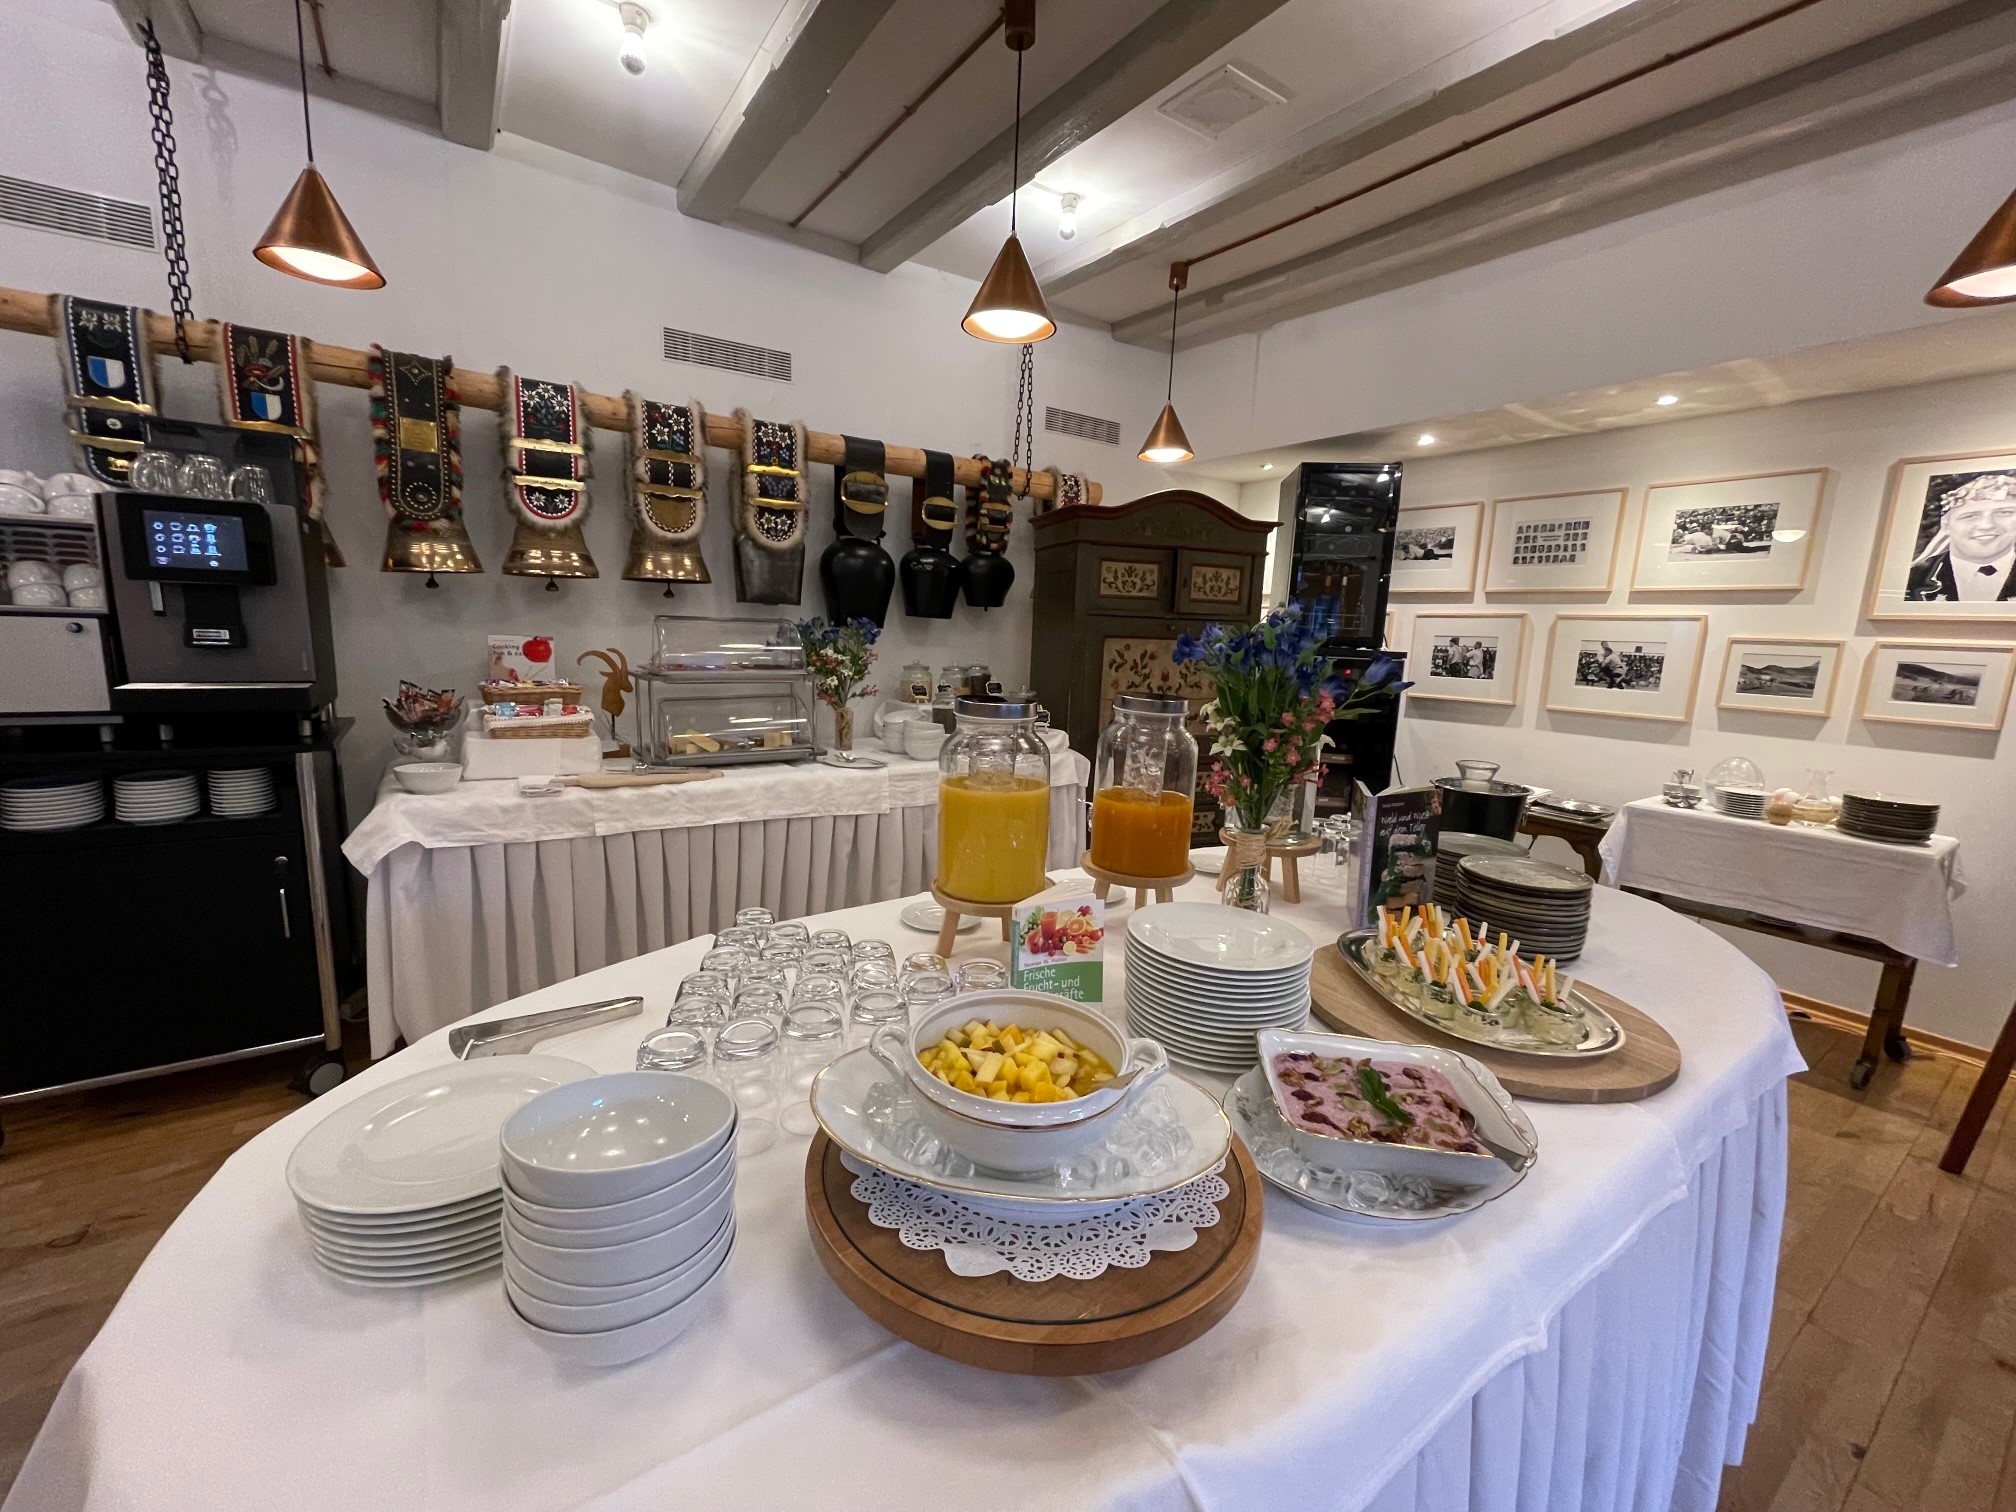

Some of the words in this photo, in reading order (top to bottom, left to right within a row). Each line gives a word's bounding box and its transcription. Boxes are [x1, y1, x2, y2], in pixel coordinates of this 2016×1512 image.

[1024, 967, 1056, 982] Frische
[1024, 980, 1060, 991] Frucht-
[1061, 976, 1080, 988] und
